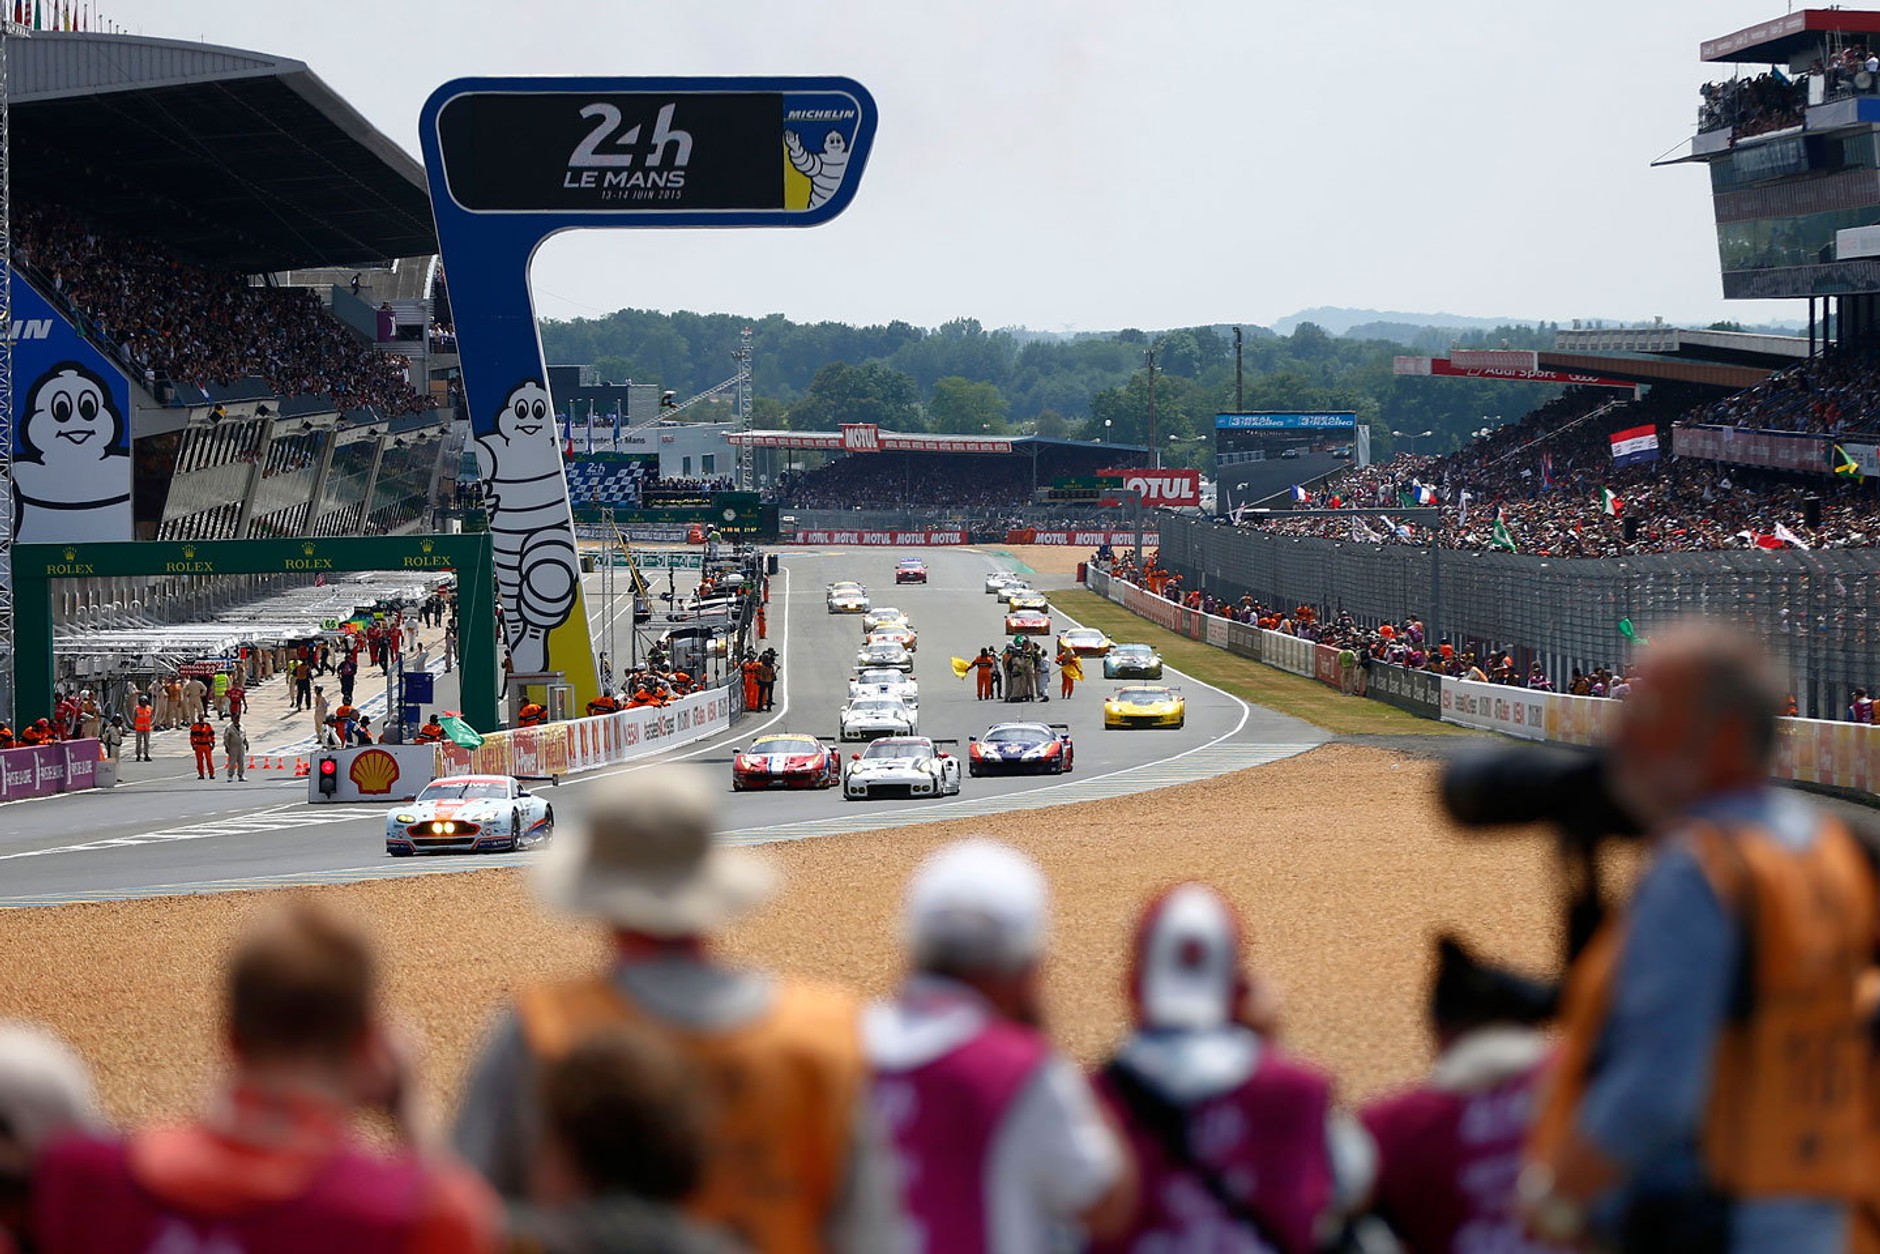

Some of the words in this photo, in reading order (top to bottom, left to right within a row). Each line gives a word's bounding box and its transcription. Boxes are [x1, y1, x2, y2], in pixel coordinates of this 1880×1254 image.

[788, 109, 856, 119] MICHELIN
[568, 102, 693, 167] 24h
[563, 171, 599, 188] LE
[603, 171, 686, 188] MANS
[601, 190, 629, 200] 13-14
[632, 190, 655, 200] JUIN
[658, 190, 682, 200] 2015
[845, 428, 878, 448] MOTUL
[1123, 477, 1194, 499] OTUL
[833, 533, 859, 544] MOTUL
[862, 533, 892, 544] MOTUL
[896, 533, 926, 544] MOTUL
[930, 533, 962, 544] MOTUL
[1035, 533, 1068, 545] MOTUL
[1074, 533, 1105, 545] MOTUL
[1111, 533, 1136, 546] MOTU
[284, 559, 333, 569] ROLEX
[404, 556, 451, 566] ROLEX
[46, 565, 94, 574] ROLEX
[166, 562, 213, 572] ROLEX
